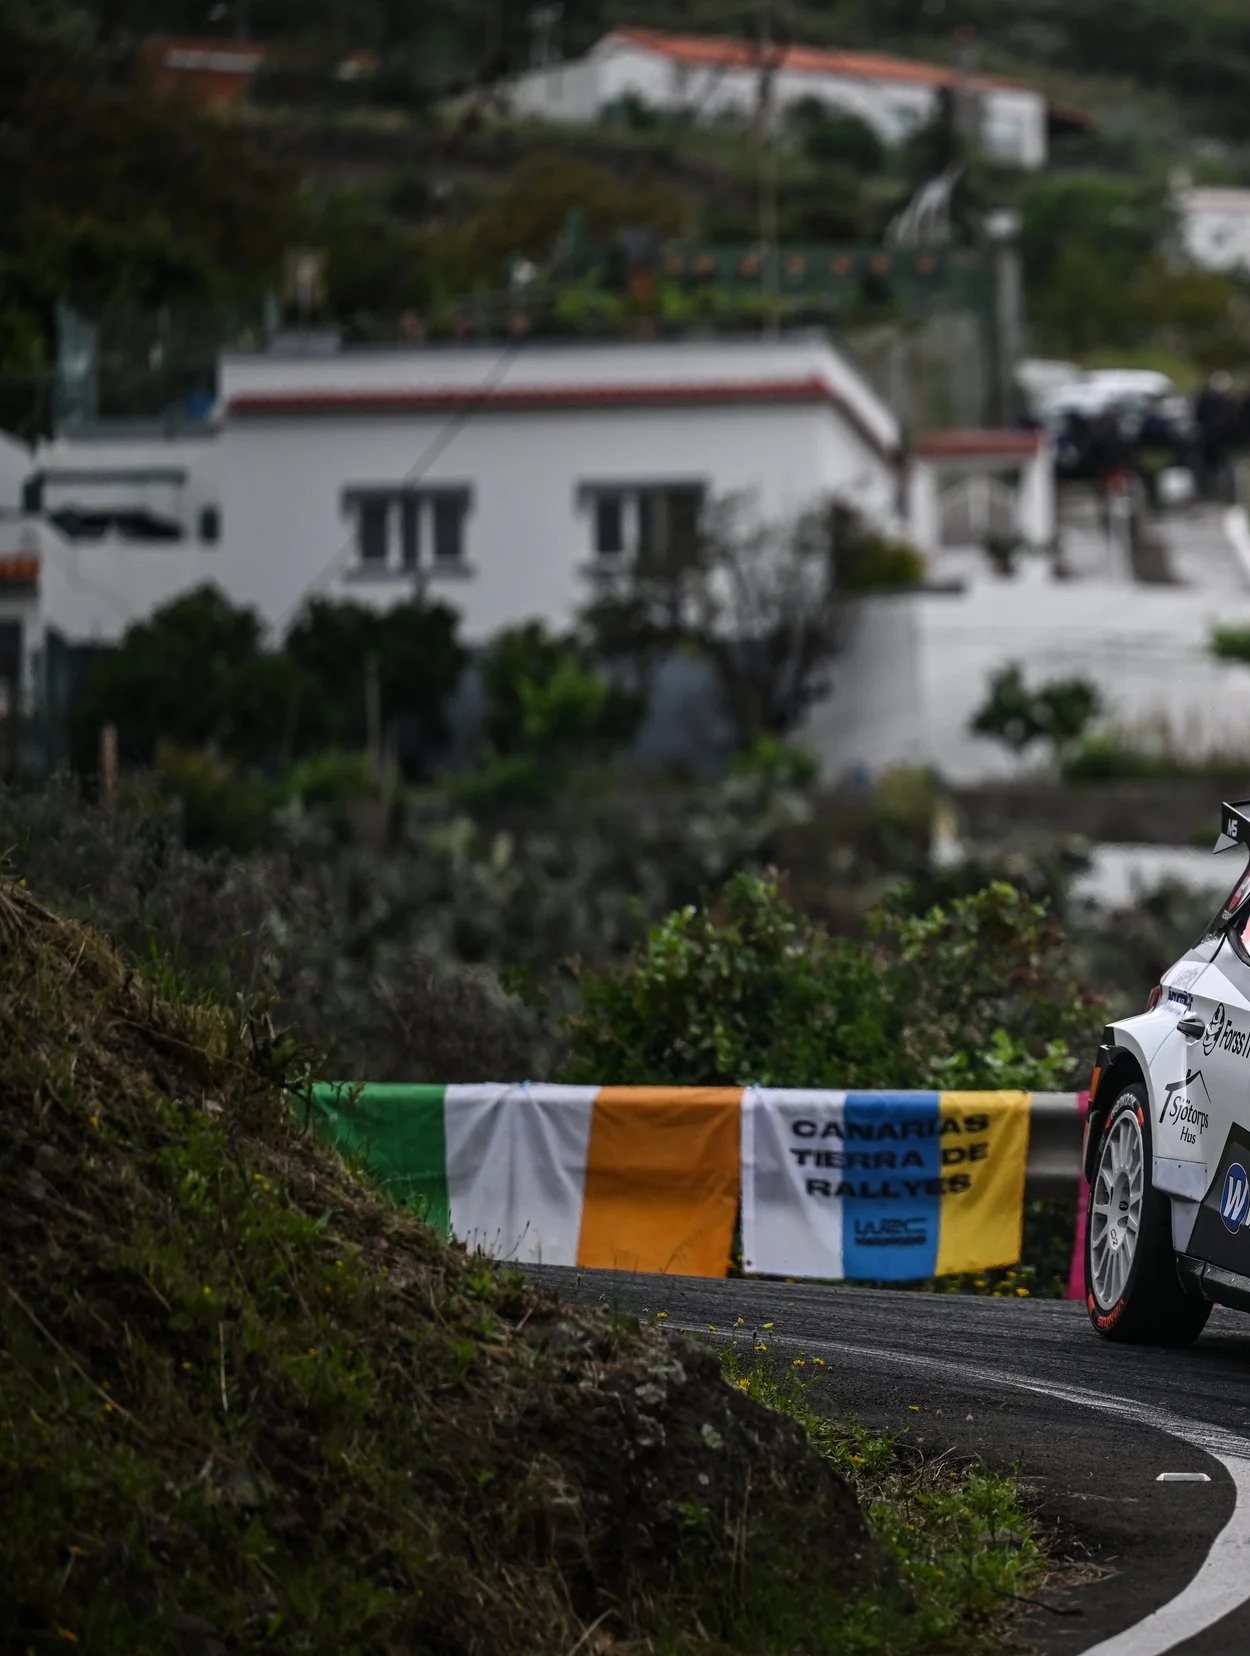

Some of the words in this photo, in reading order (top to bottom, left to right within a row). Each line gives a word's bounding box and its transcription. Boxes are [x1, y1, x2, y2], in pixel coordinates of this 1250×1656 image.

[1219, 1020, 1246, 1056] Forss
[791, 1115, 990, 1141] CANARIAS
[1180, 1126, 1197, 1144] Hus
[789, 1147, 925, 1169] TIERRA
[941, 1143, 989, 1166] DE
[806, 1174, 972, 1200] RALLYES
